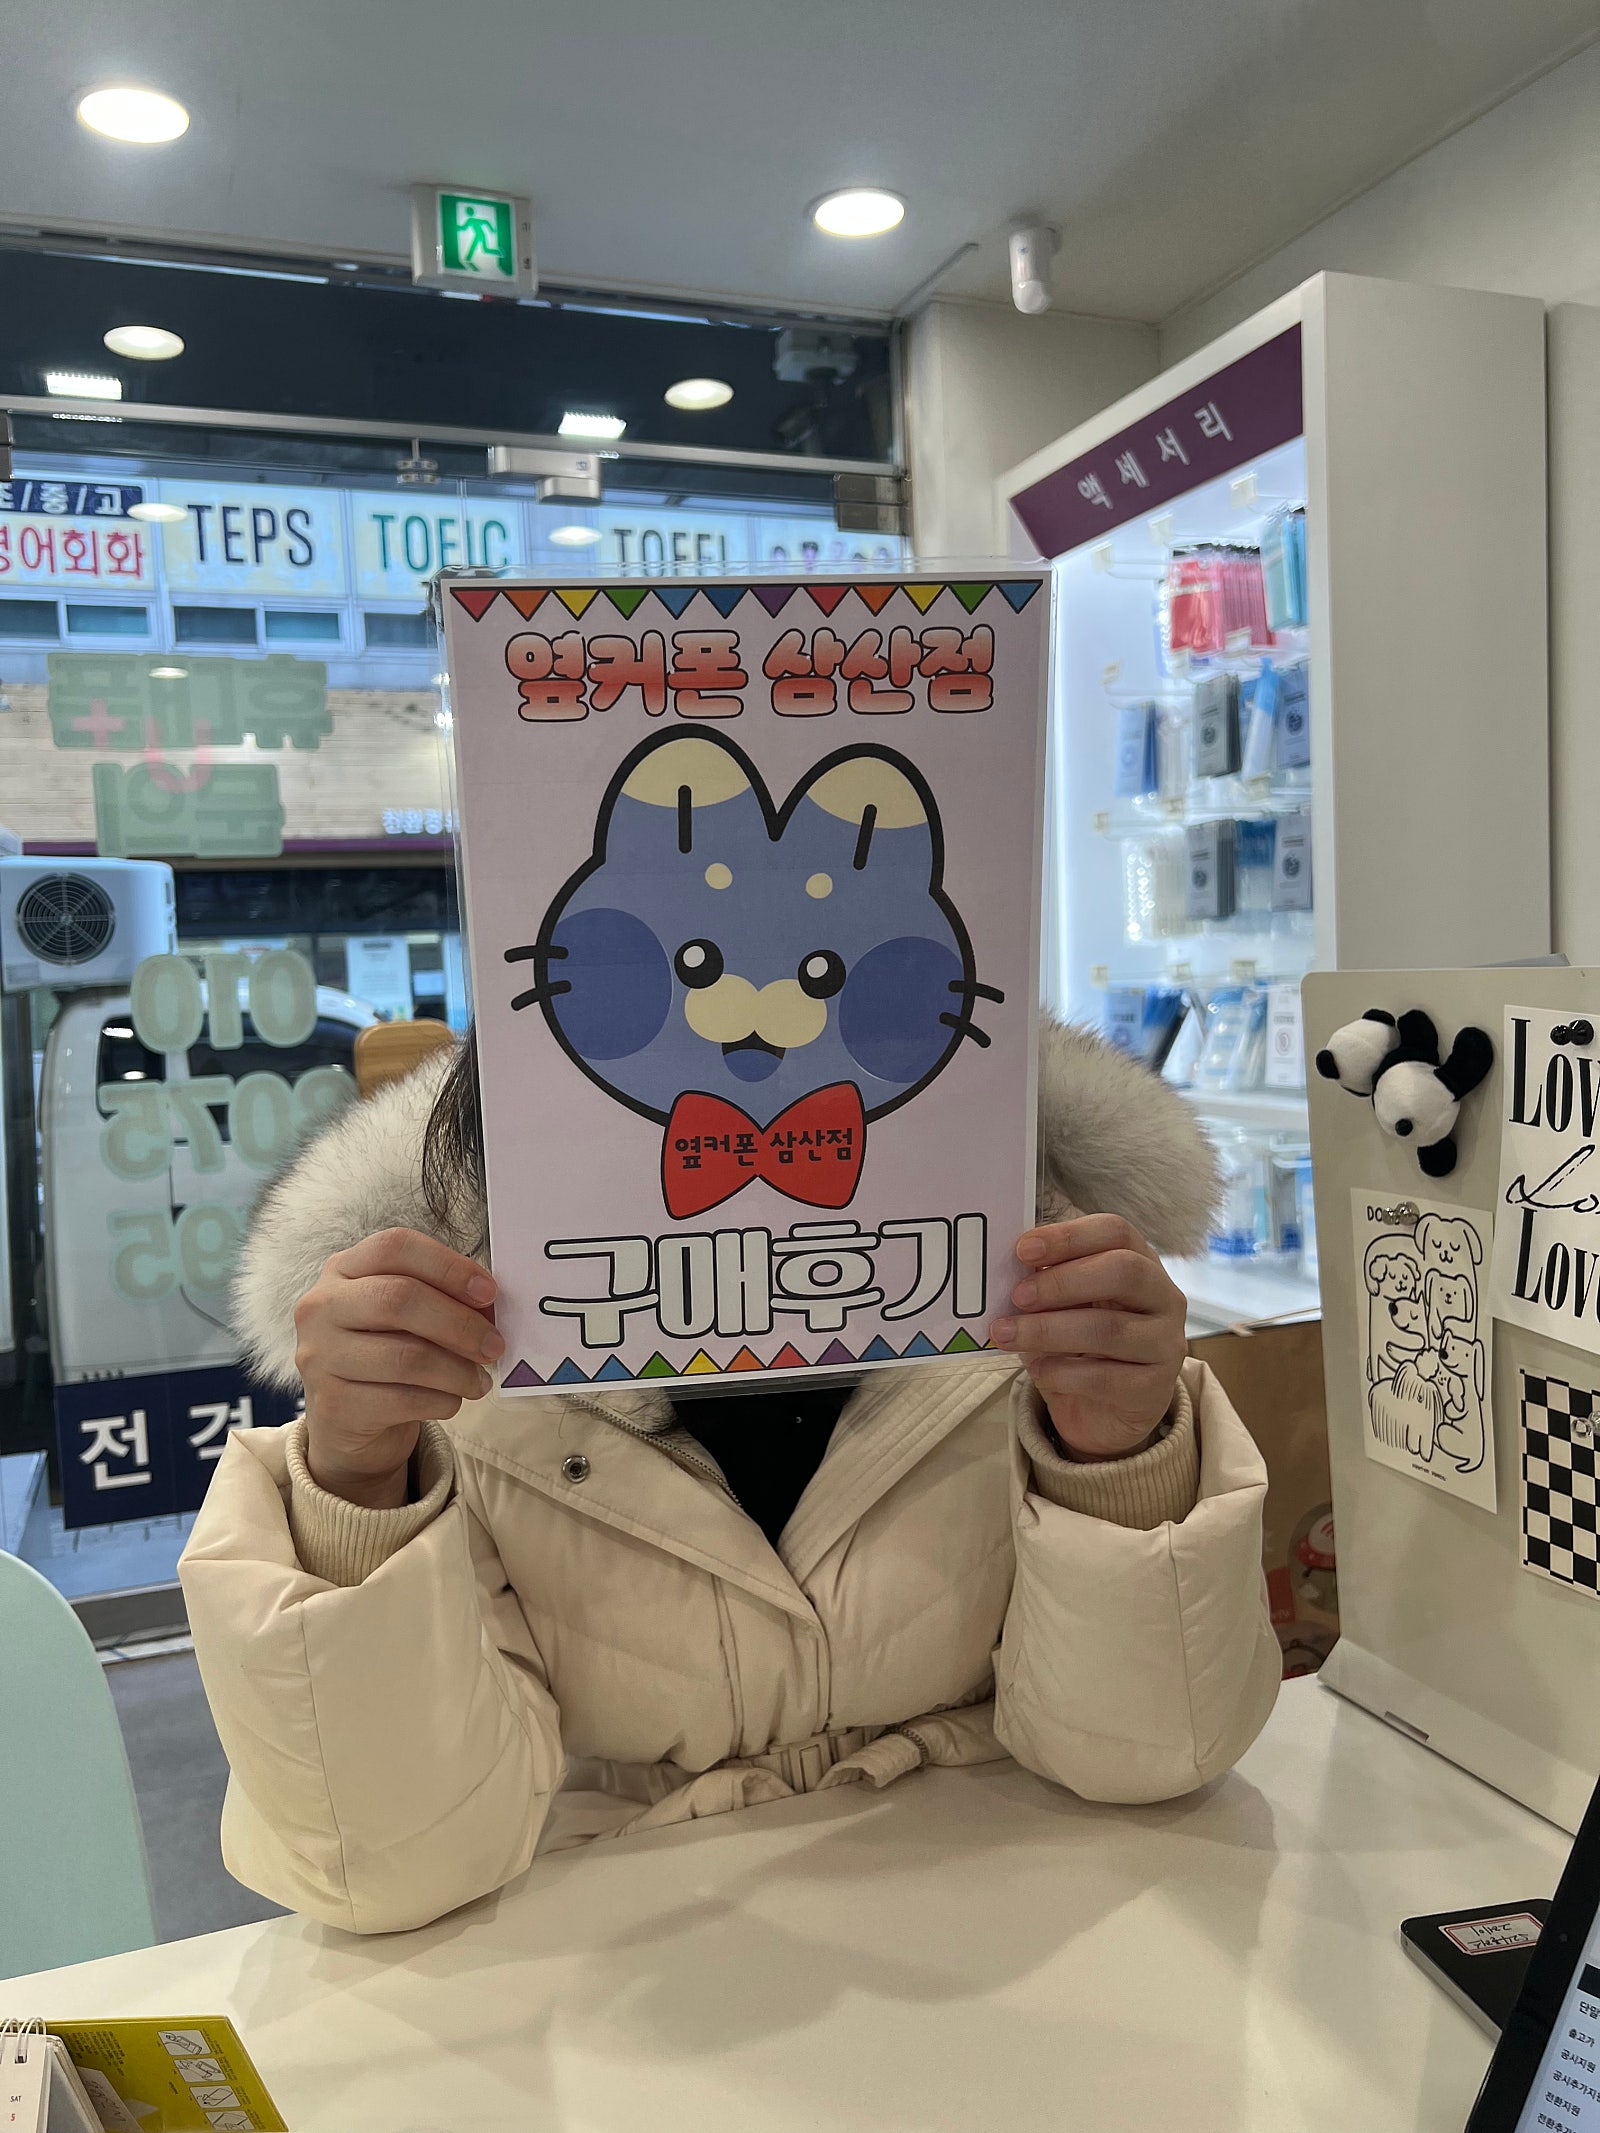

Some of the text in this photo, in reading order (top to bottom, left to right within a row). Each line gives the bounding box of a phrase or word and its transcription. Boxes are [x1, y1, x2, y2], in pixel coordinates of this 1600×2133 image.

[1076, 401, 1235, 510] 액세서리
[187, 504, 314, 566] TEPS
[372, 514, 508, 573] TOEIC
[505, 624, 996, 723] 옆커폰 삼산점
[675, 1127, 853, 1169] 옆커폰 삼산점
[1506, 1144, 1600, 1214] Lo
[539, 1213, 988, 1349] 구매후기
[1511, 1206, 1600, 1322] Lov
[1579, 2001, 1600, 2020] 단말
[1560, 2048, 1597, 2074] 공시지원
[1568, 2028, 1595, 2048] 출고가
[10, 2095, 22, 2103] SAT
[1537, 2112, 1577, 2133] 전환추가
[1544, 2091, 1581, 2117] 전환지원
